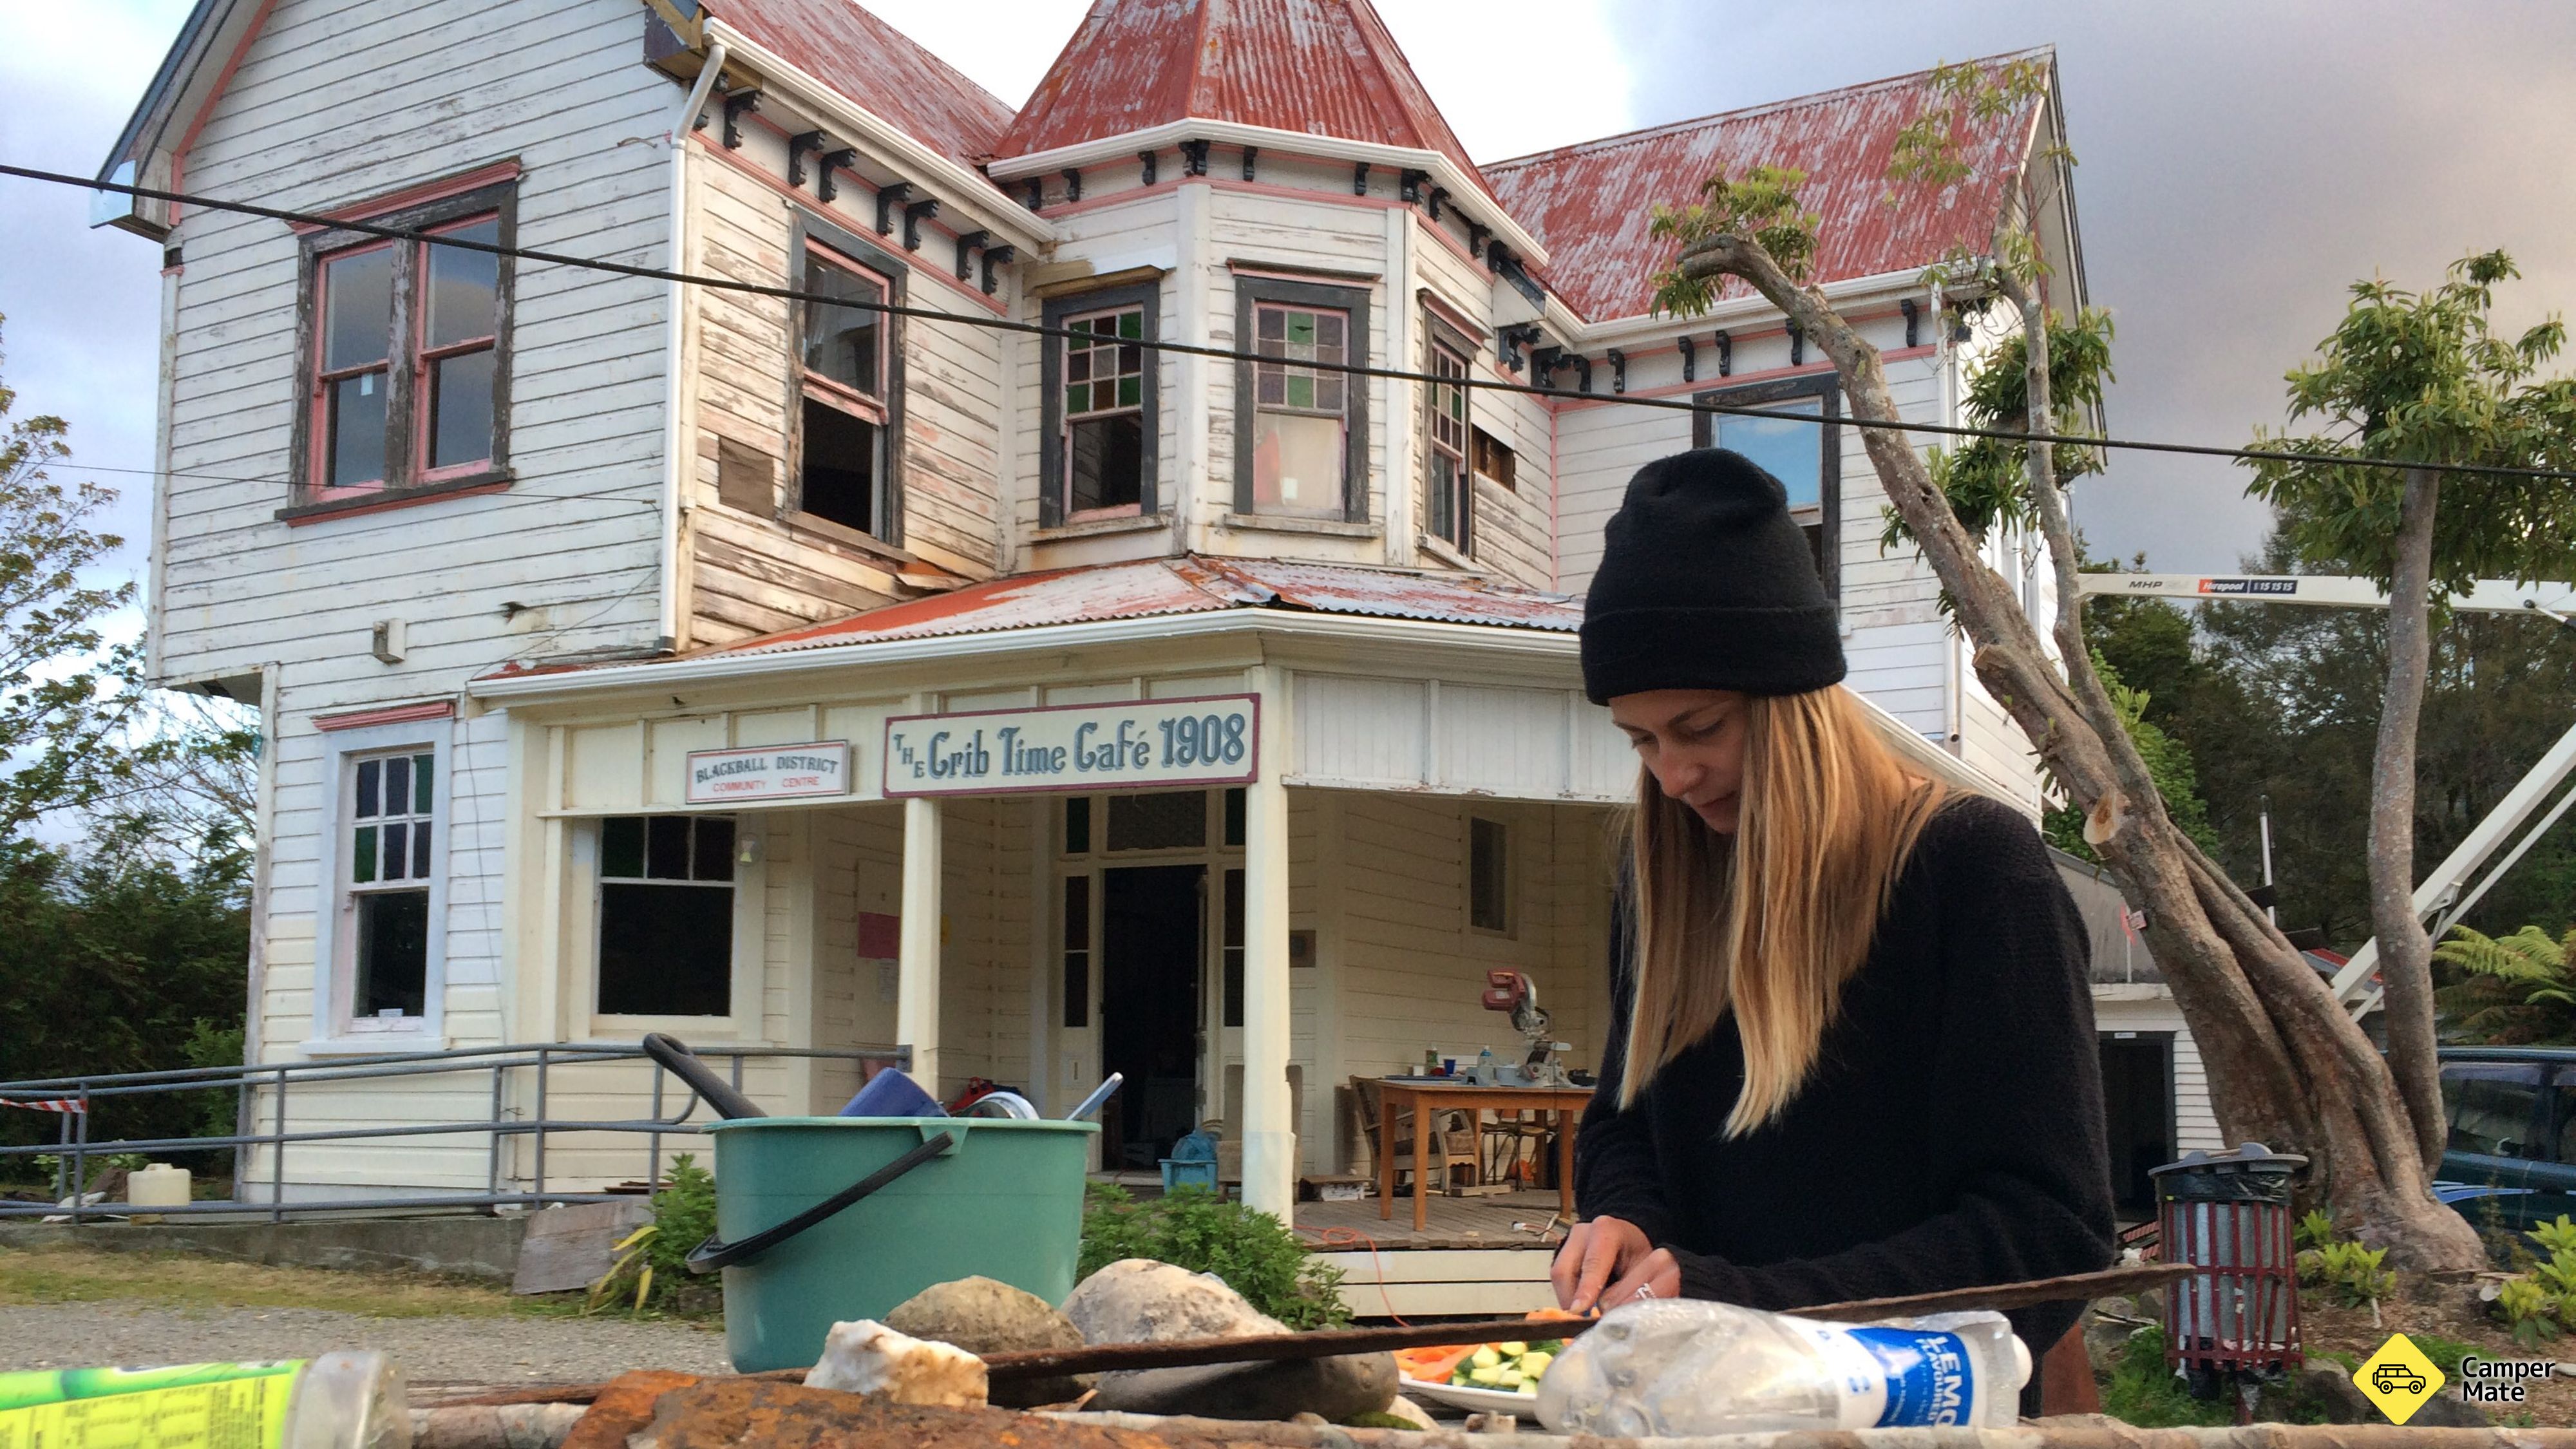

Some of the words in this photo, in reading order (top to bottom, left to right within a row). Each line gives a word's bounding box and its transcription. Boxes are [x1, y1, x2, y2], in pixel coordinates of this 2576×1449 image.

[893, 734, 925, 778] THE
[928, 728, 990, 779] Crib
[997, 726, 1067, 775] Time
[1074, 719, 1150, 772] Café
[1158, 712, 1245, 768] 1908
[696, 757, 768, 783] BLACKBALL
[776, 755, 838, 774] DISTRICT
[713, 780, 766, 792] COMMUNITY
[782, 776, 820, 788] CENTRE
